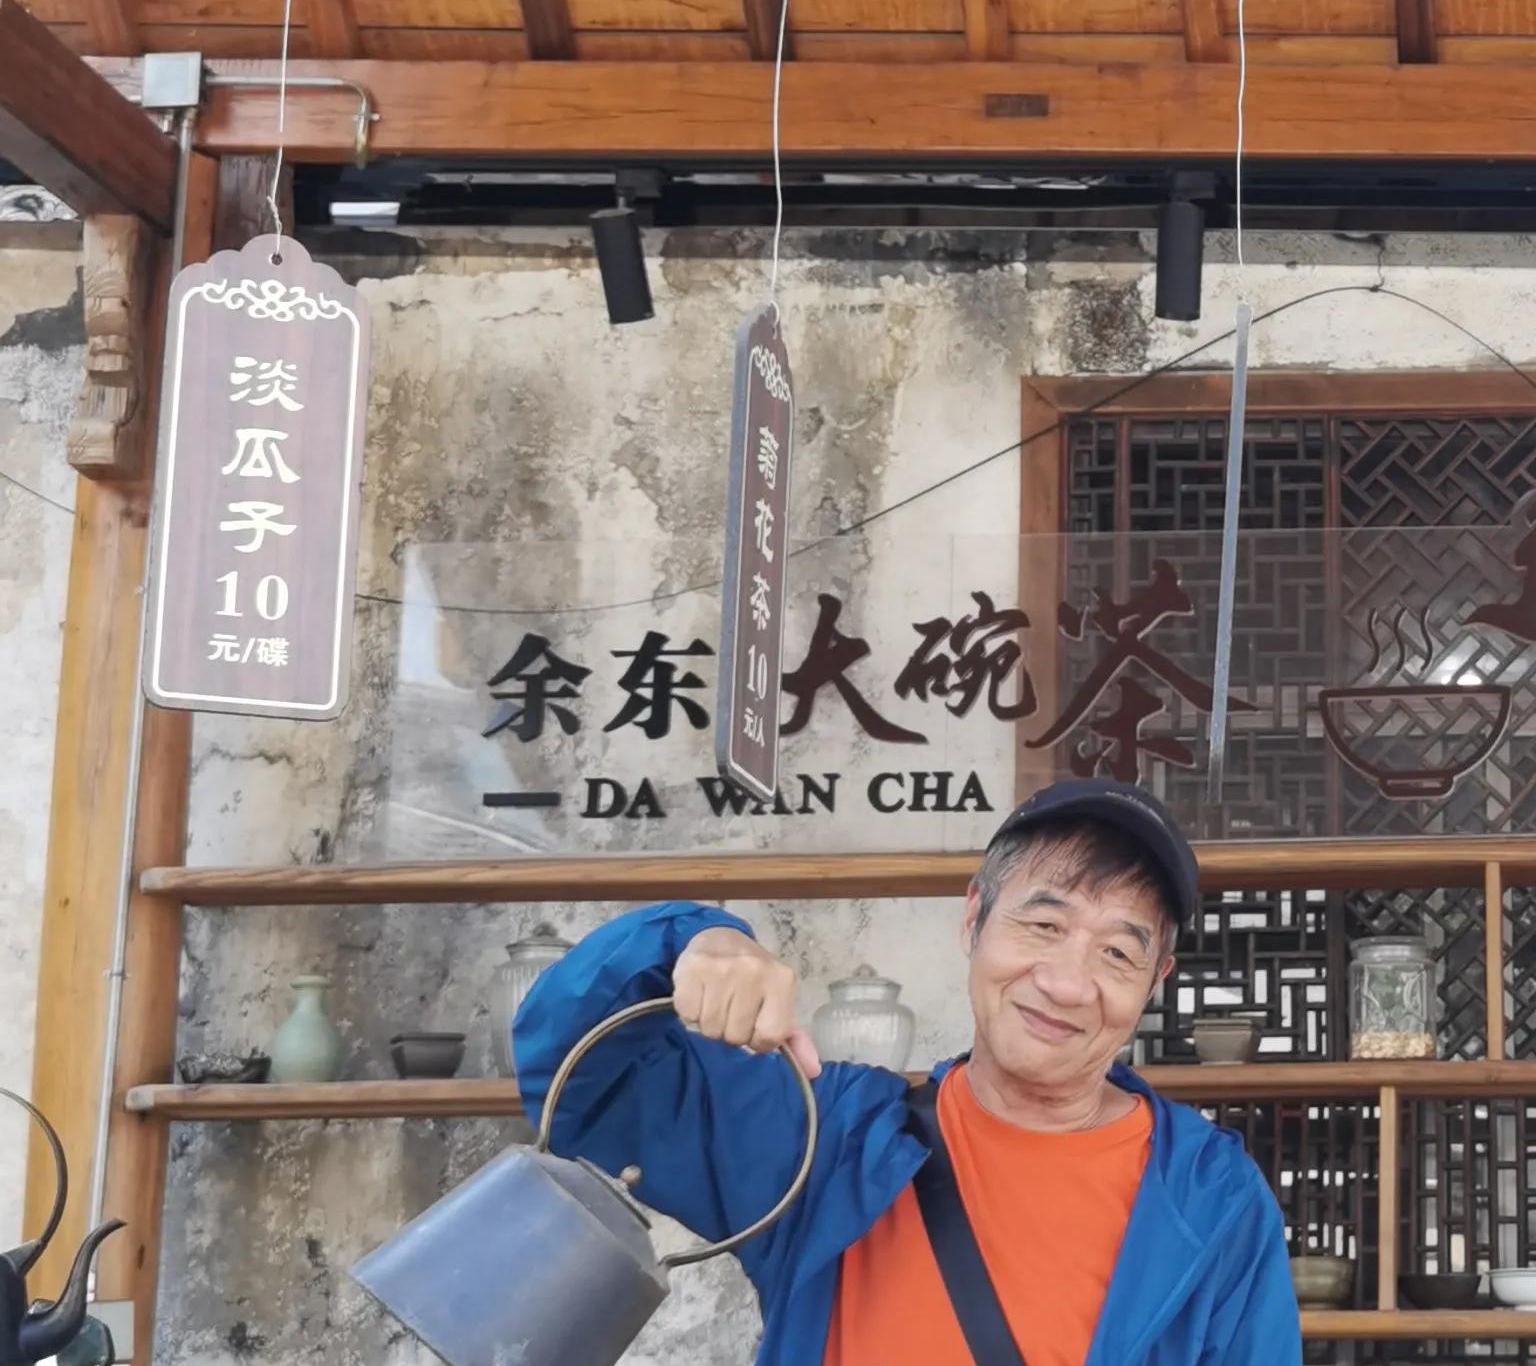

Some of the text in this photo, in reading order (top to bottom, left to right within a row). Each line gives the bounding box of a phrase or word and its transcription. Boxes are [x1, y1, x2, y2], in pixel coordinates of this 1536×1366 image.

[219, 355, 304, 554] 淡瓜子
[215, 571, 290, 621] 10
[206, 632, 291, 668] 元/碟
[747, 644, 769, 701] 10
[580, 777, 667, 820] DA
[868, 769, 995, 815] CHA
